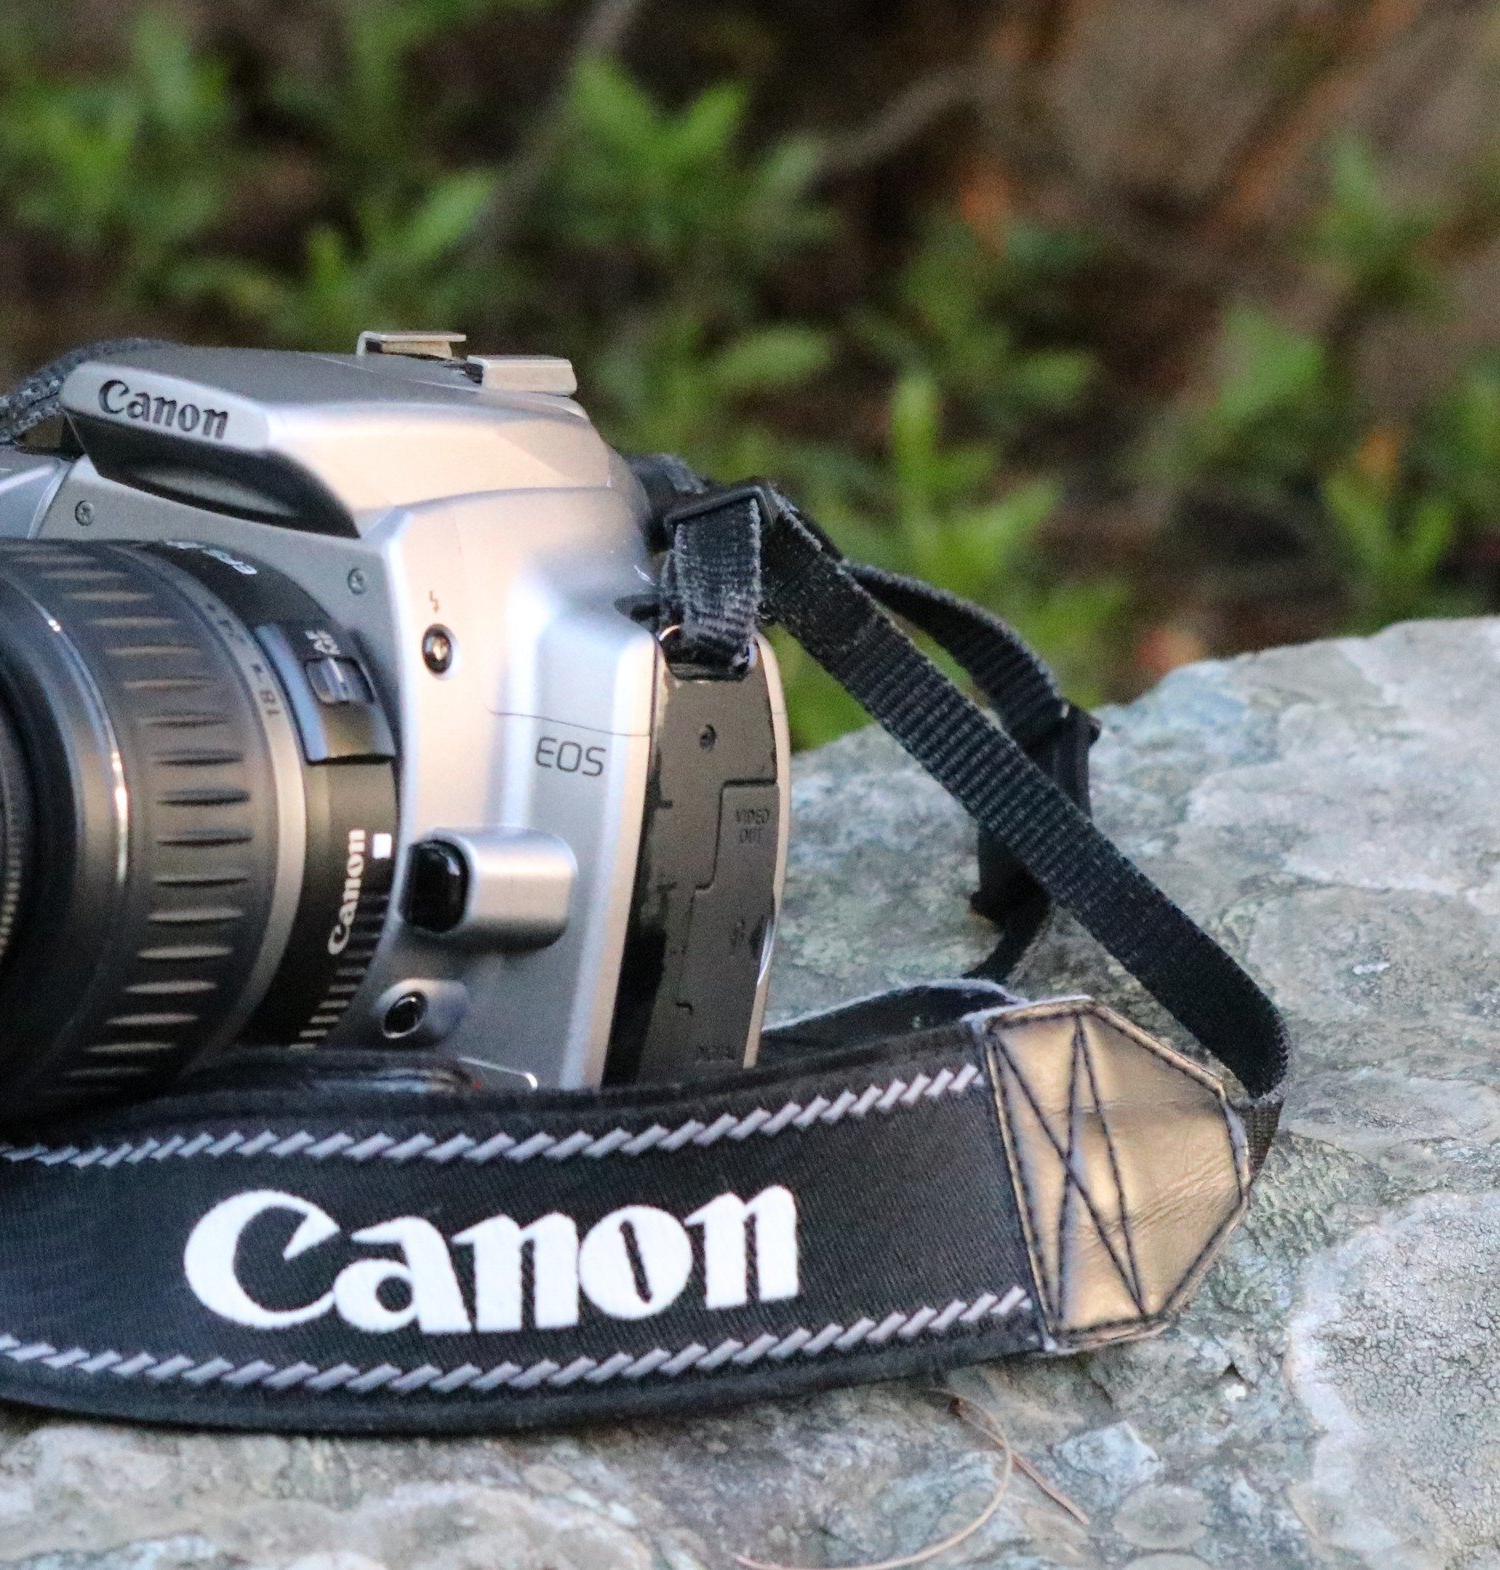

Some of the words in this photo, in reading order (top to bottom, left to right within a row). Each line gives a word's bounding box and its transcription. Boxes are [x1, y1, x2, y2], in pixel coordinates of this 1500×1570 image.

[99, 379, 228, 440] Canon
[536, 736, 606, 777] EOS
[327, 829, 366, 954] Canon
[183, 1185, 800, 1334] Canon
